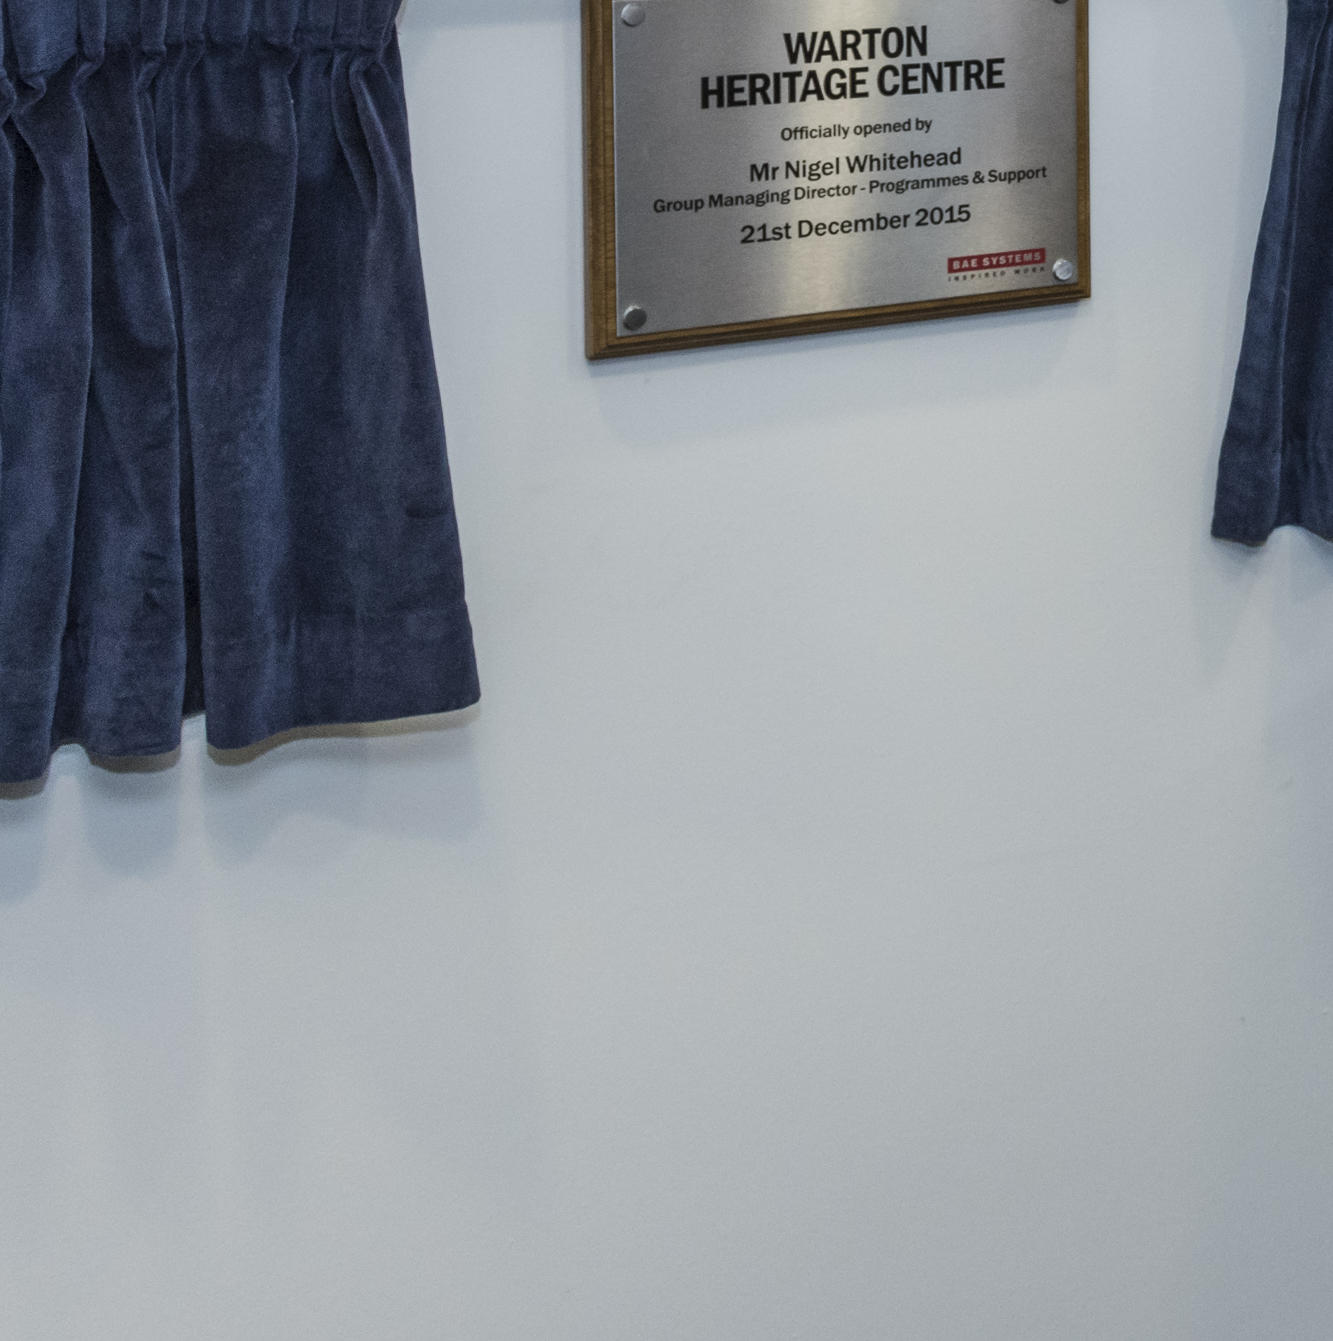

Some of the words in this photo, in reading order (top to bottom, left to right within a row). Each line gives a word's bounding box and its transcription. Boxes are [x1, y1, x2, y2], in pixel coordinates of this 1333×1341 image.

[783, 25, 928, 65] WARTON
[700, 66, 870, 109] HERITAGE
[876, 57, 1006, 97] CENTRE
[780, 123, 850, 141] Officially
[853, 119, 912, 138] opened
[915, 117, 933, 134] by
[750, 162, 780, 183] Mr
[784, 157, 841, 182] Nigel
[846, 147, 963, 174] Whitehead
[653, 197, 705, 214] Group
[708, 189, 791, 208] Managing
[794, 184, 858, 201] Director
[869, 175, 969, 195] Programmes
[972, 170, 985, 184] &
[988, 166, 1048, 185] Support
[740, 222, 793, 245] 21st
[797, 213, 911, 239] December
[915, 204, 972, 228] 2015
[952, 259, 978, 270] BAE
[982, 252, 1041, 266] SYSTEMS
